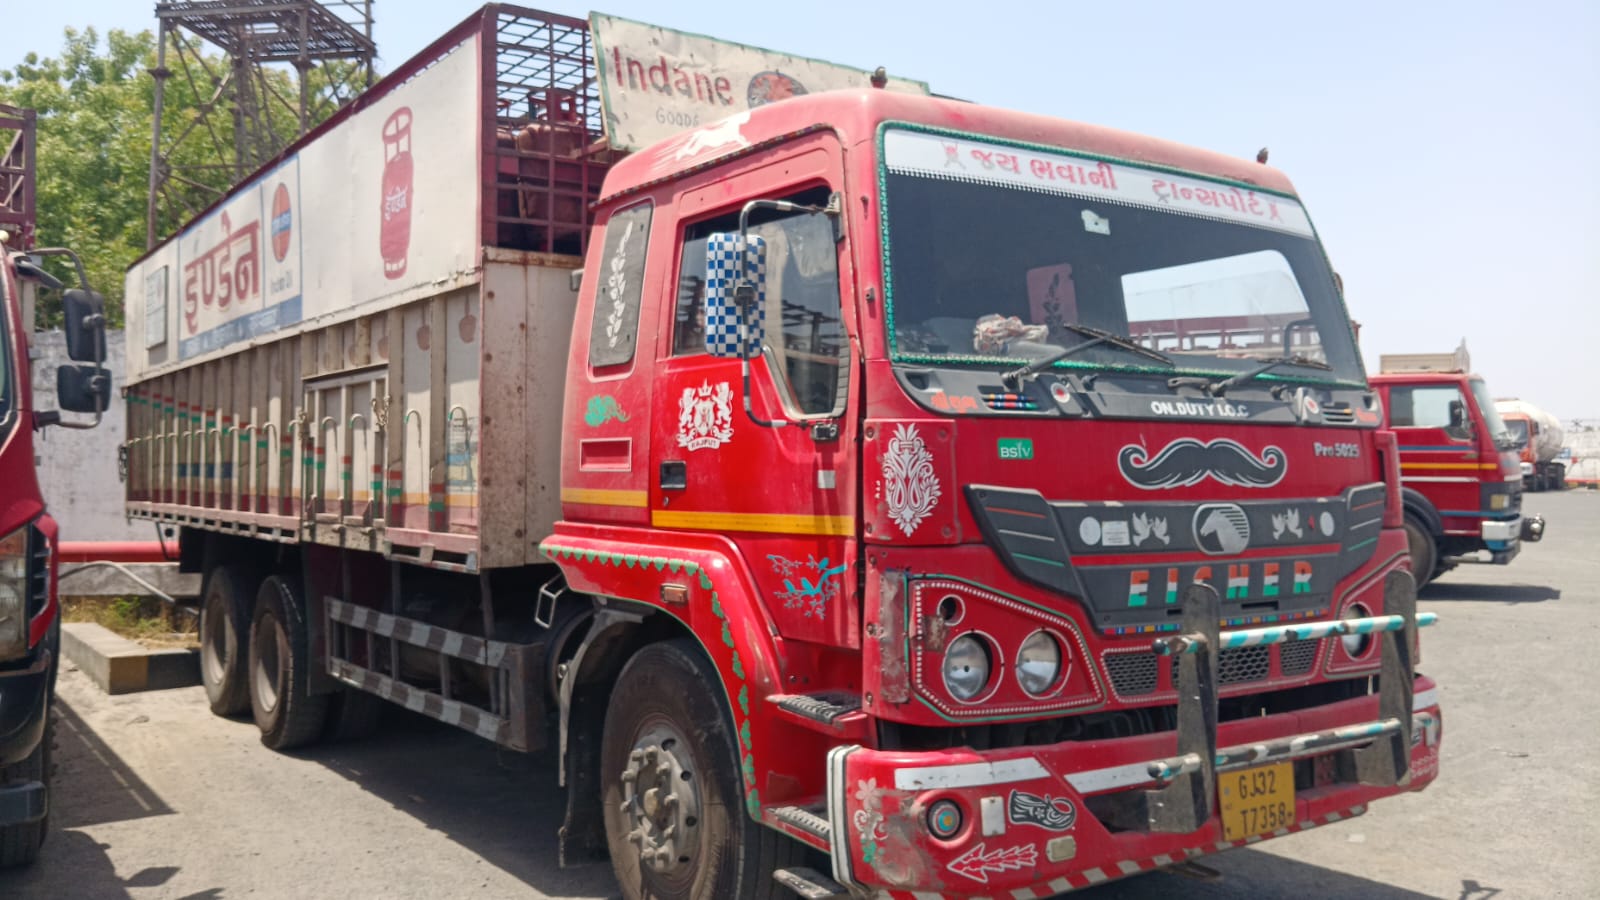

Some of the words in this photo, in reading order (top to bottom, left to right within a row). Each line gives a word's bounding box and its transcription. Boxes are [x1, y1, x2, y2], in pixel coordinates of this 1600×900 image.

[613, 47, 734, 106] Indane
[970, 148, 1020, 174] જય
[1029, 158, 1118, 190] ભવાની
[184, 209, 260, 335] इण्डेन
[1313, 441, 1334, 457] Pro
[1239, 769, 1277, 799] GJ32
[1241, 801, 1286, 834] T7358
